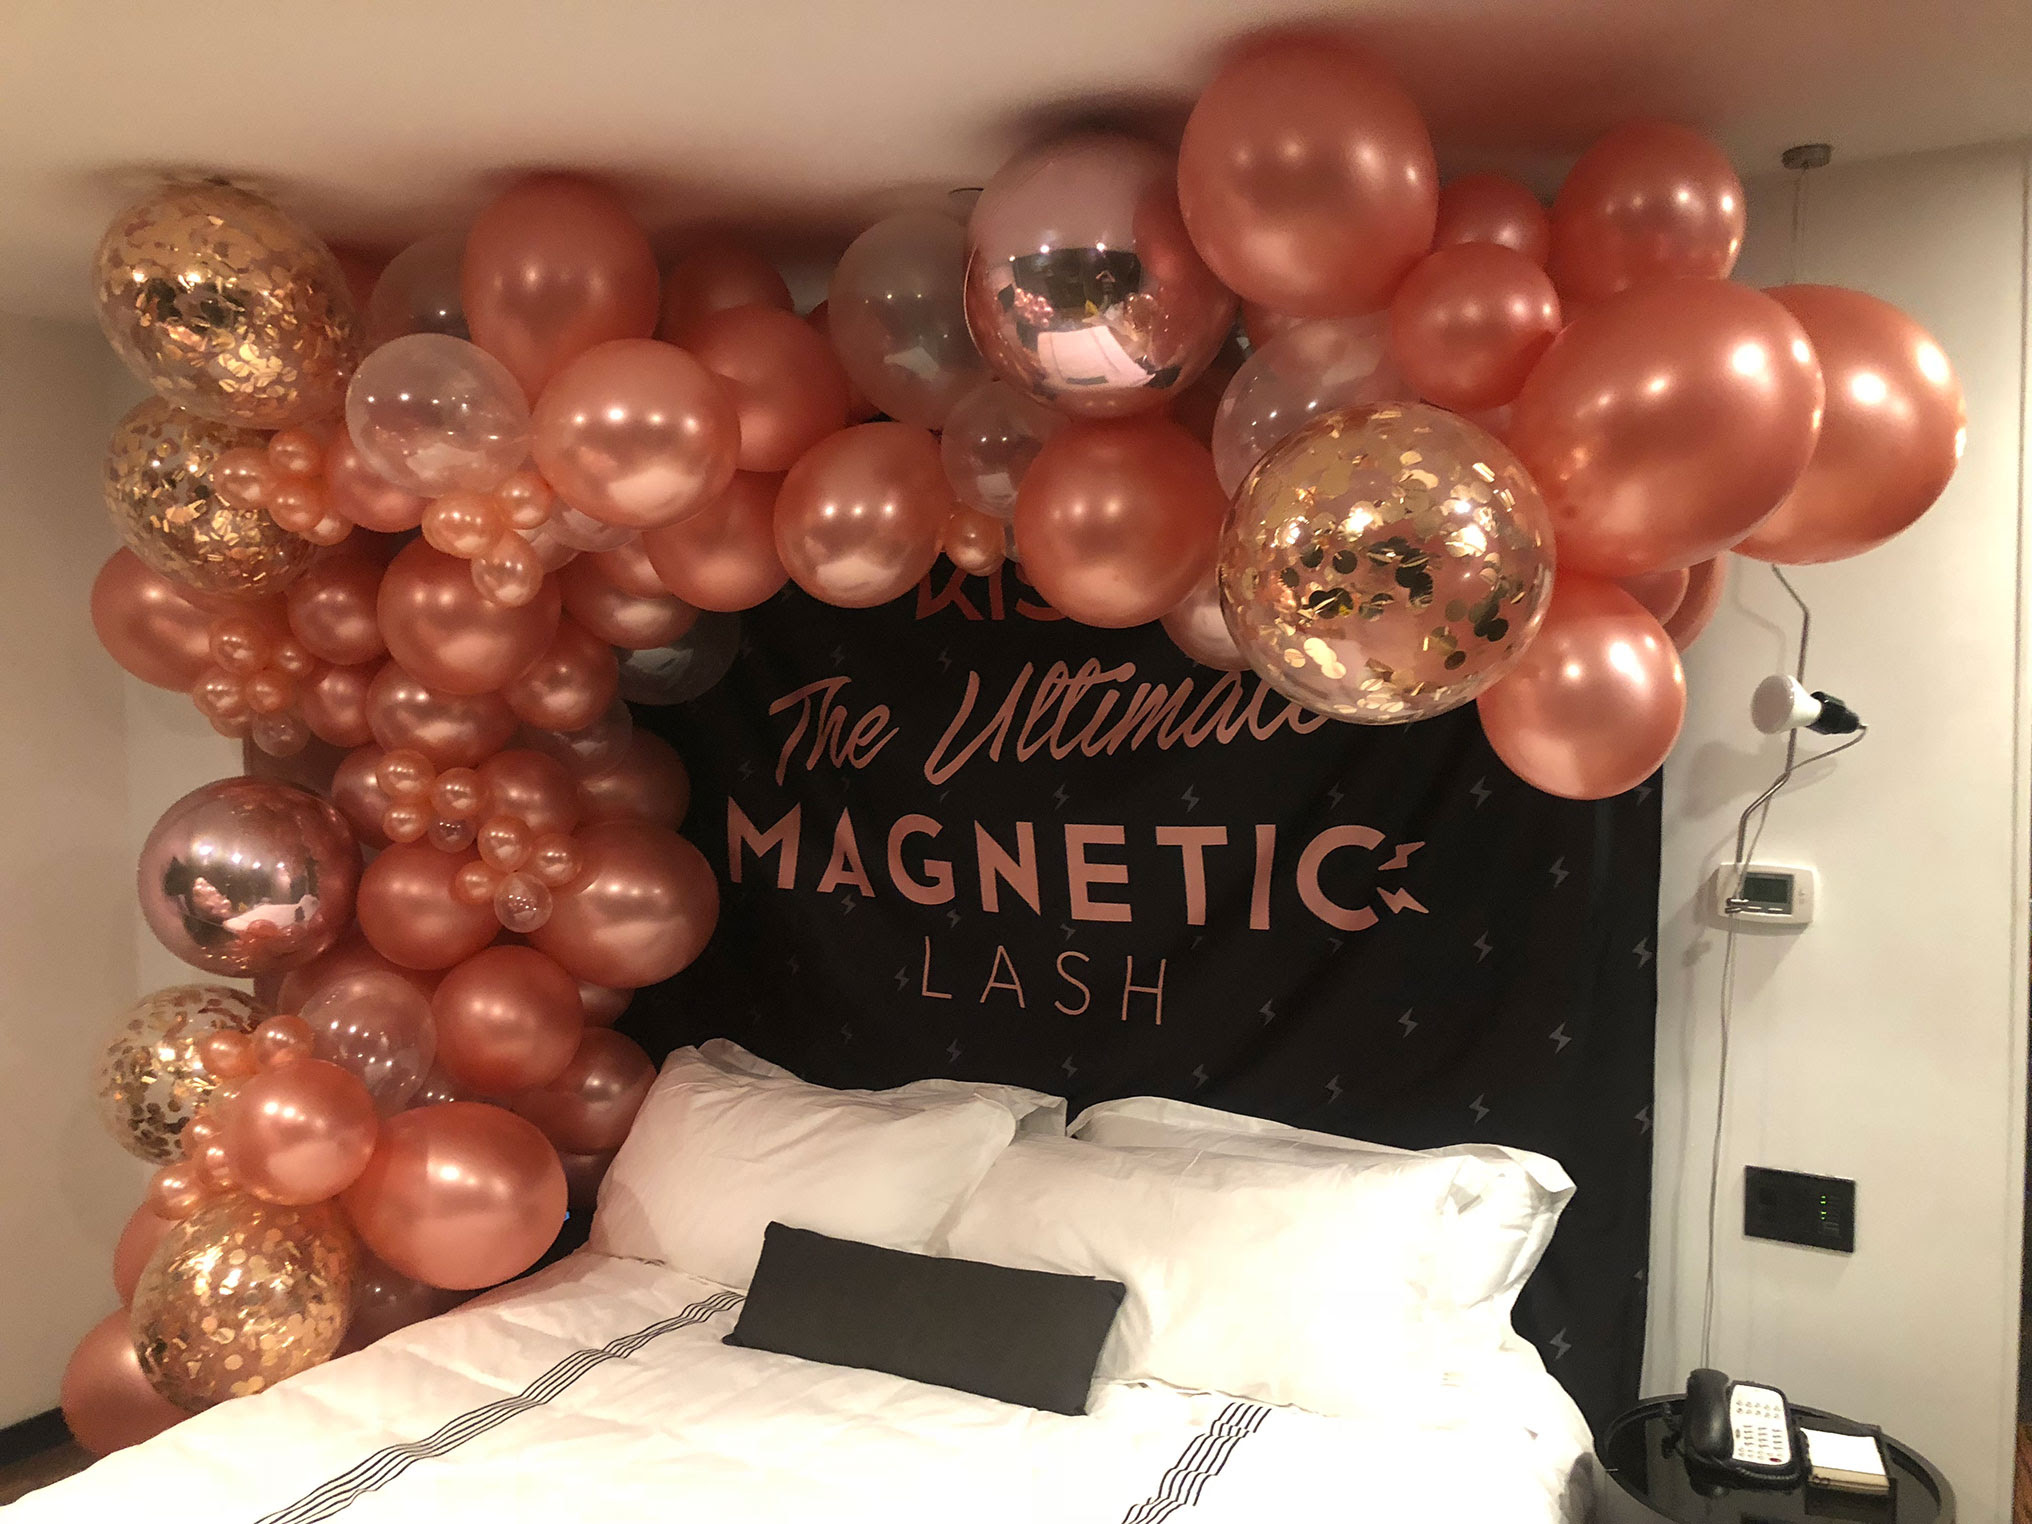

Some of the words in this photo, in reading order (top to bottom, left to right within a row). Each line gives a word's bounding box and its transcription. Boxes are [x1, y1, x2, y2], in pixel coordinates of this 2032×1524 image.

[768, 675, 900, 787] The
[727, 796, 1387, 932] MAGNETIC
[921, 936, 1168, 1025] LASH
